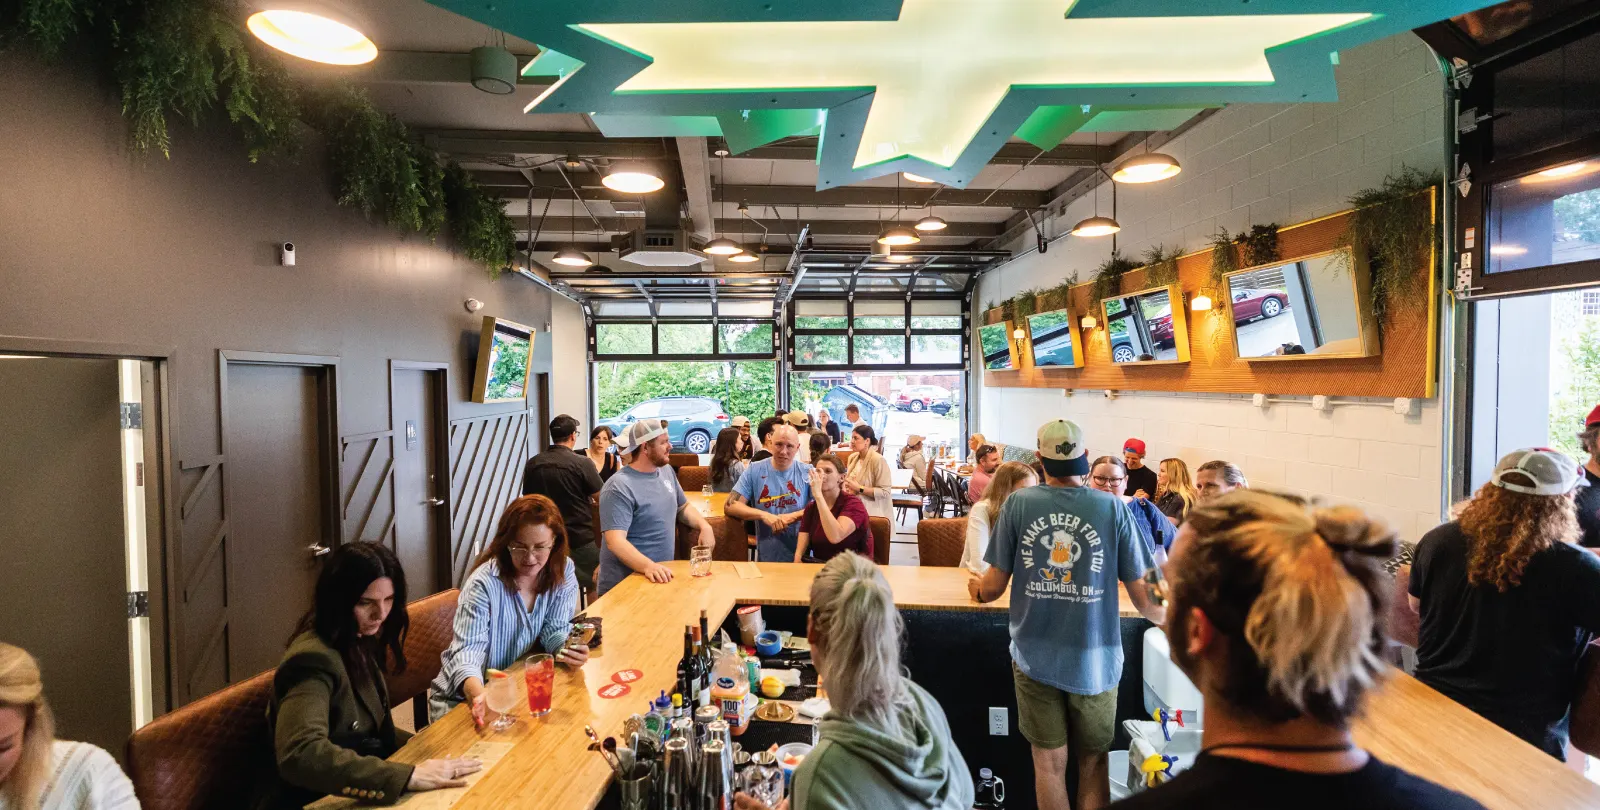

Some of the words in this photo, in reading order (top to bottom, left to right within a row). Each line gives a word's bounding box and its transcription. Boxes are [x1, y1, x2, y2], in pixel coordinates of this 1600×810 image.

[776, 496, 797, 508] Louis
[1049, 513, 1080, 529] BEER
[1022, 517, 1049, 547] MAKE
[1080, 523, 1101, 547] FOR
[1021, 549, 1034, 568] WE
[1090, 549, 1104, 573] YOU
[1030, 581, 1079, 596] COLUMBUS,
[1082, 586, 1094, 596] OH
